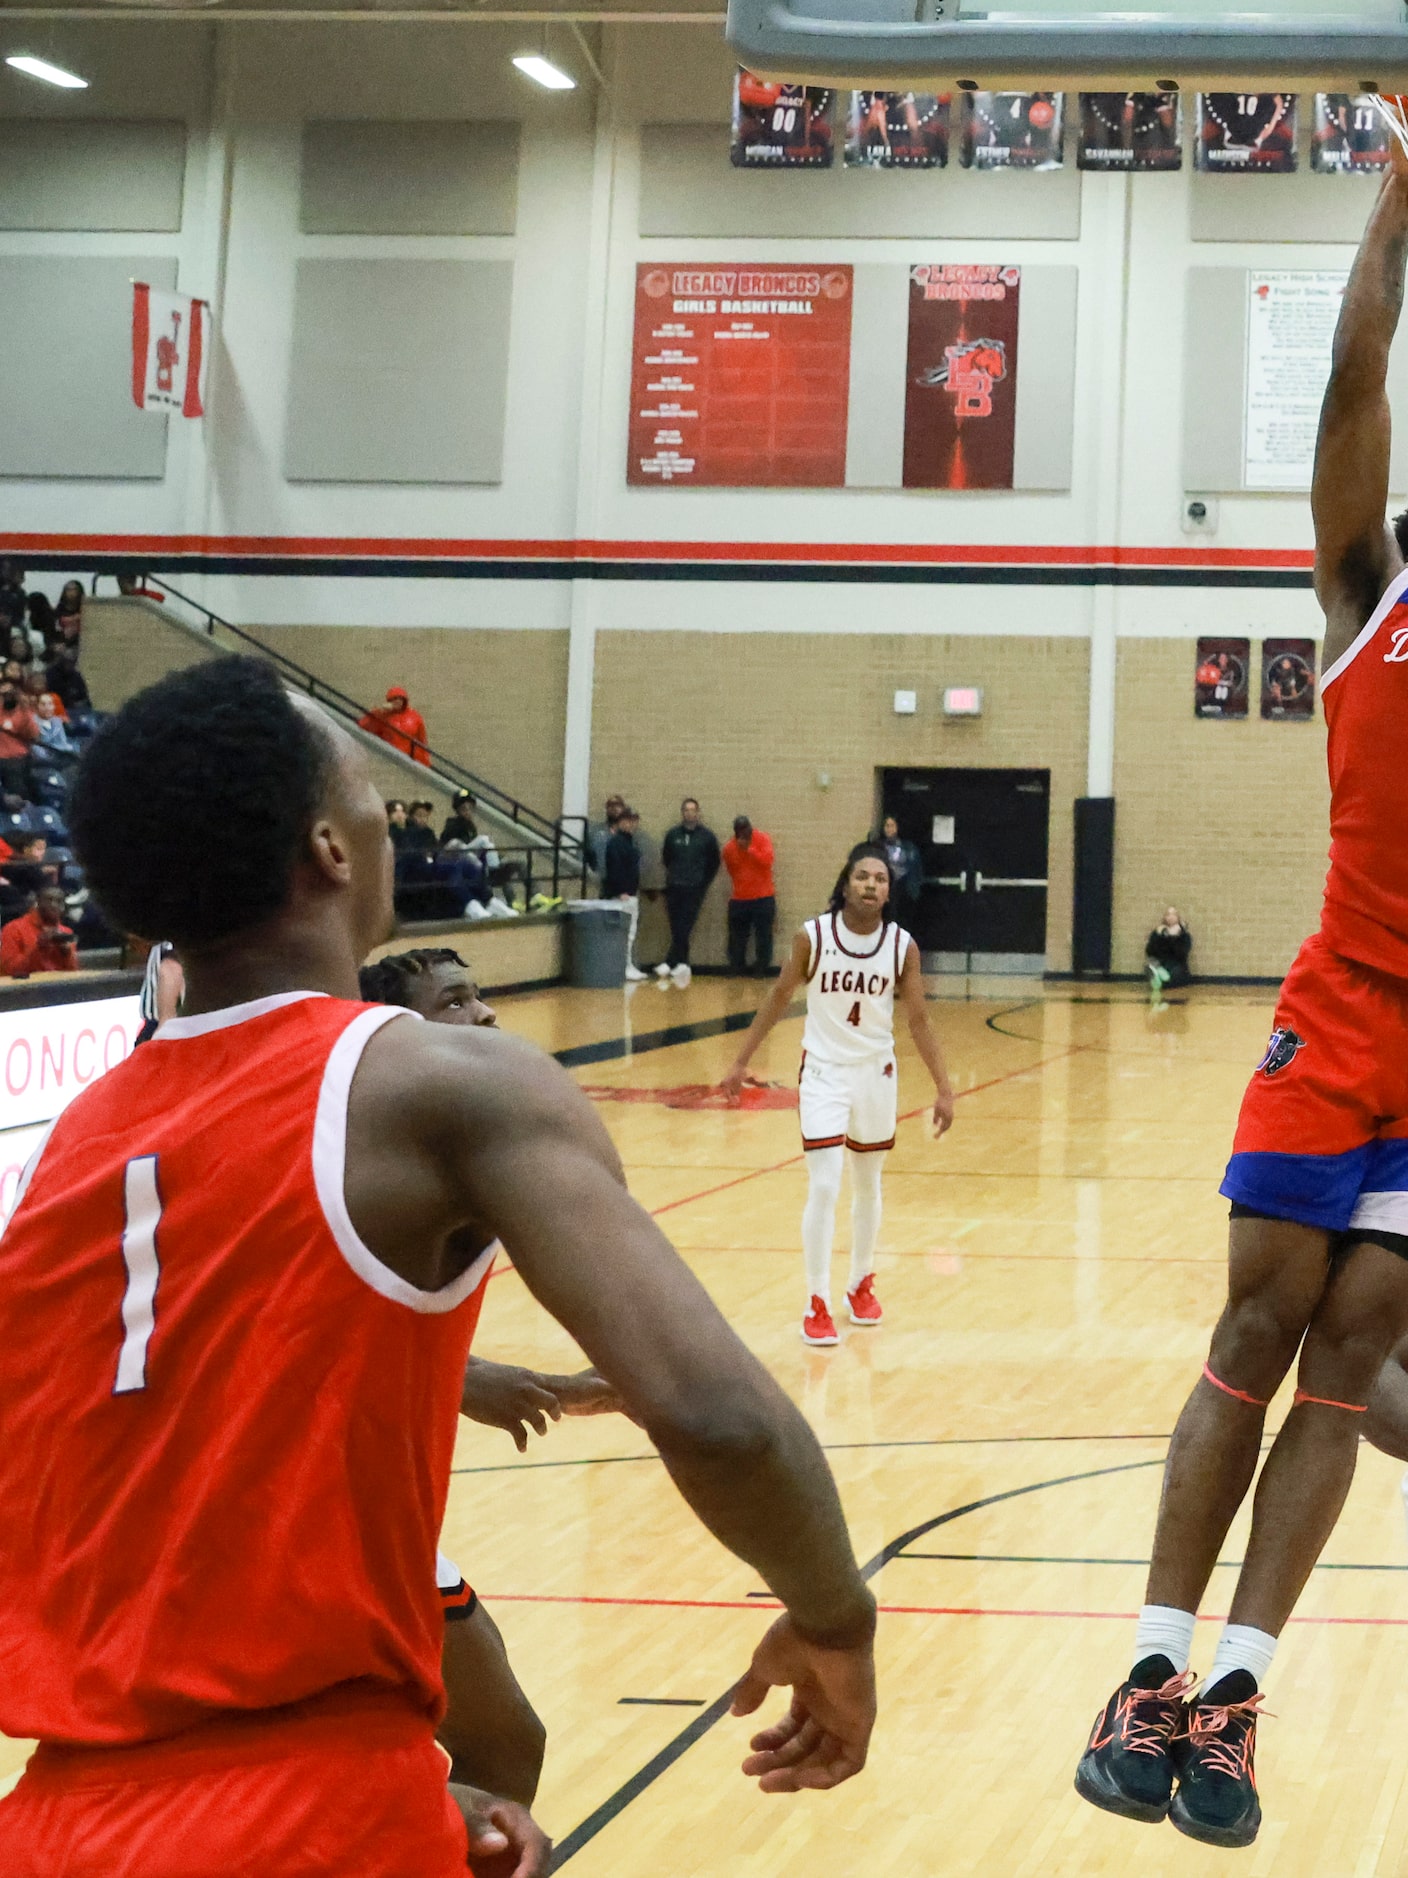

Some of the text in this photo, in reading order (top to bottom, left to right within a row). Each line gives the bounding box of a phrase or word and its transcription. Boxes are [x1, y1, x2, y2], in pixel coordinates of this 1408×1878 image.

[1238, 95, 1258, 116] 10
[772, 108, 796, 133] 00
[1355, 109, 1373, 131] 11
[674, 272, 820, 296] LEGACY BRONCOS
[925, 283, 1005, 300] BRONCOS
[673, 300, 813, 314] GIRLS BASKETBALL
[820, 970, 890, 996] LEGACY
[847, 1001, 861, 1026] 4
[112, 1152, 163, 1395] 1
